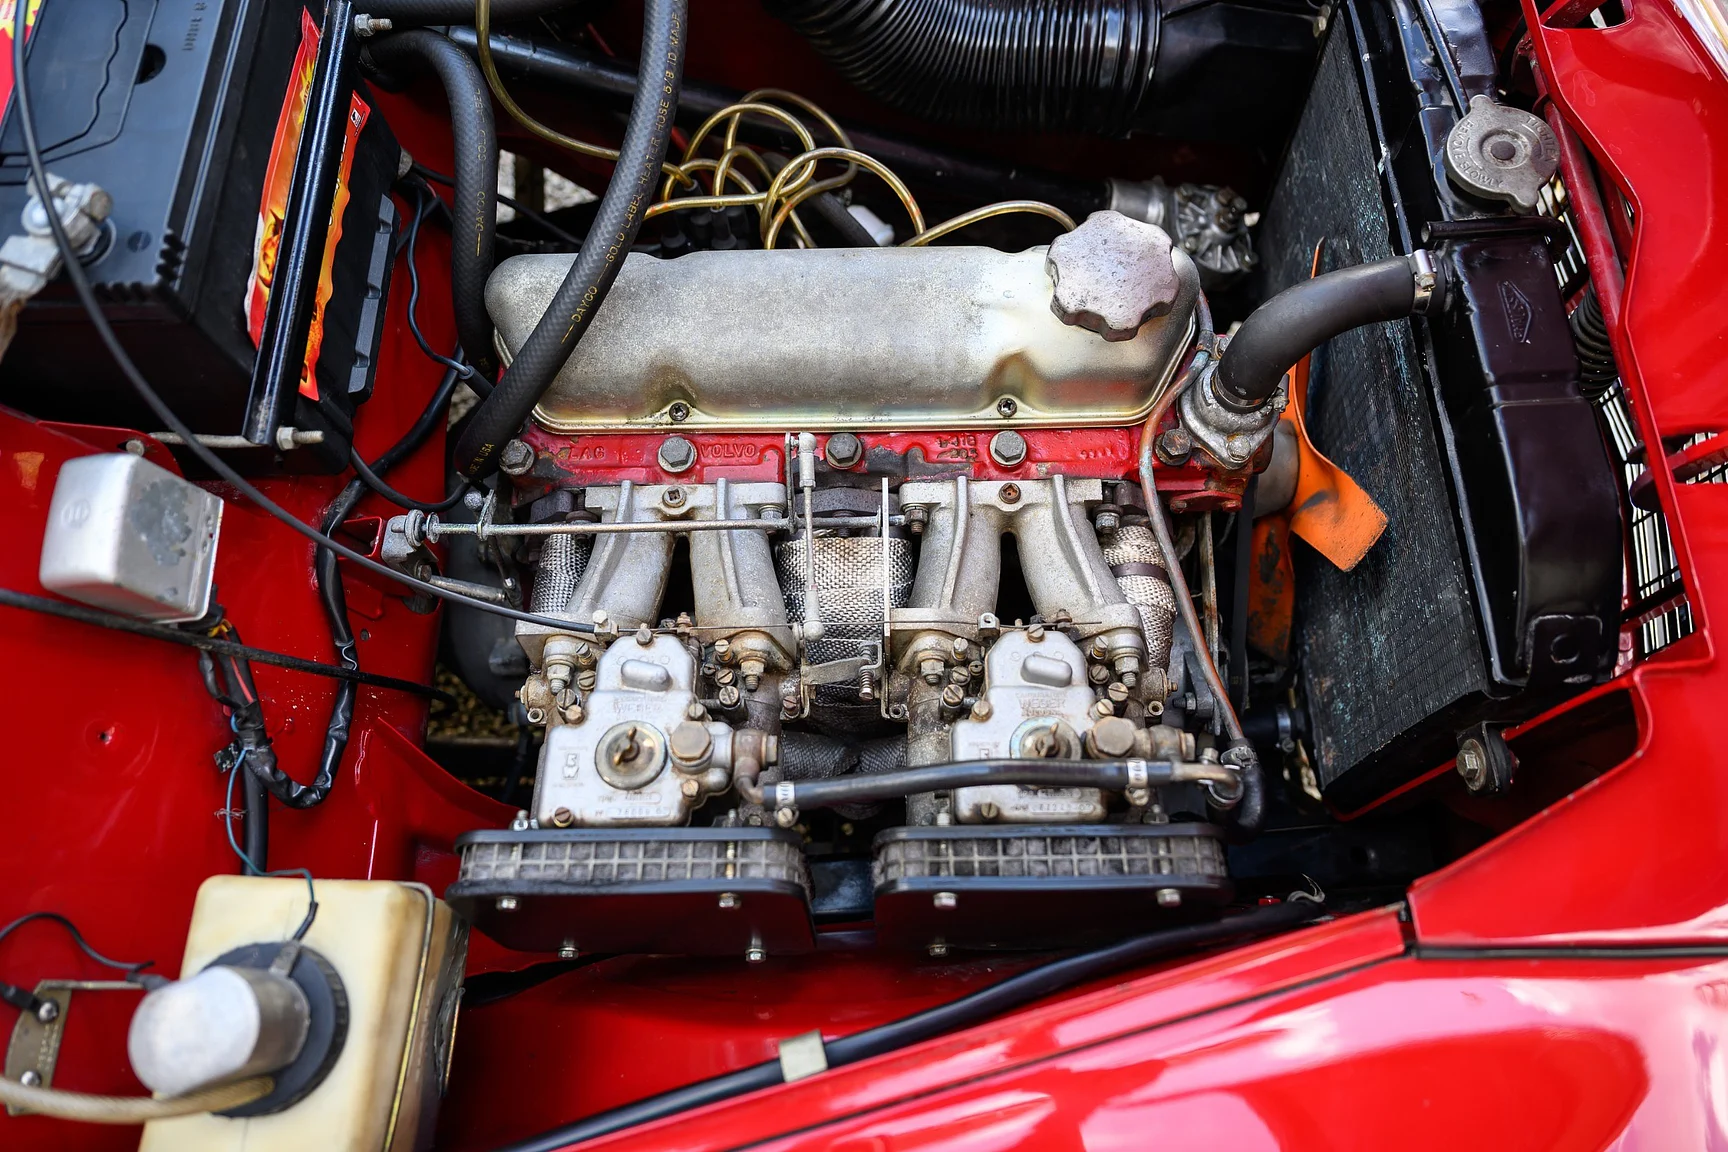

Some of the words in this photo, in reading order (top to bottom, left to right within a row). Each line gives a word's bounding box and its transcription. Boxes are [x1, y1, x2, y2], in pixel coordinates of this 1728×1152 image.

[1453, 118, 1475, 160] REMOVE
[1459, 162, 1504, 188] SLOWLY
[475, 191, 486, 233] DAYCO
[570, 285, 598, 323] DAYCO
[605, 231, 625, 262] GOLD
[621, 193, 645, 229] LABEL
[637, 136, 661, 185] HEATER
[655, 98, 670, 132] HOSE
[479, 443, 496, 457] USA
[700, 444, 757, 458] VOLVO
